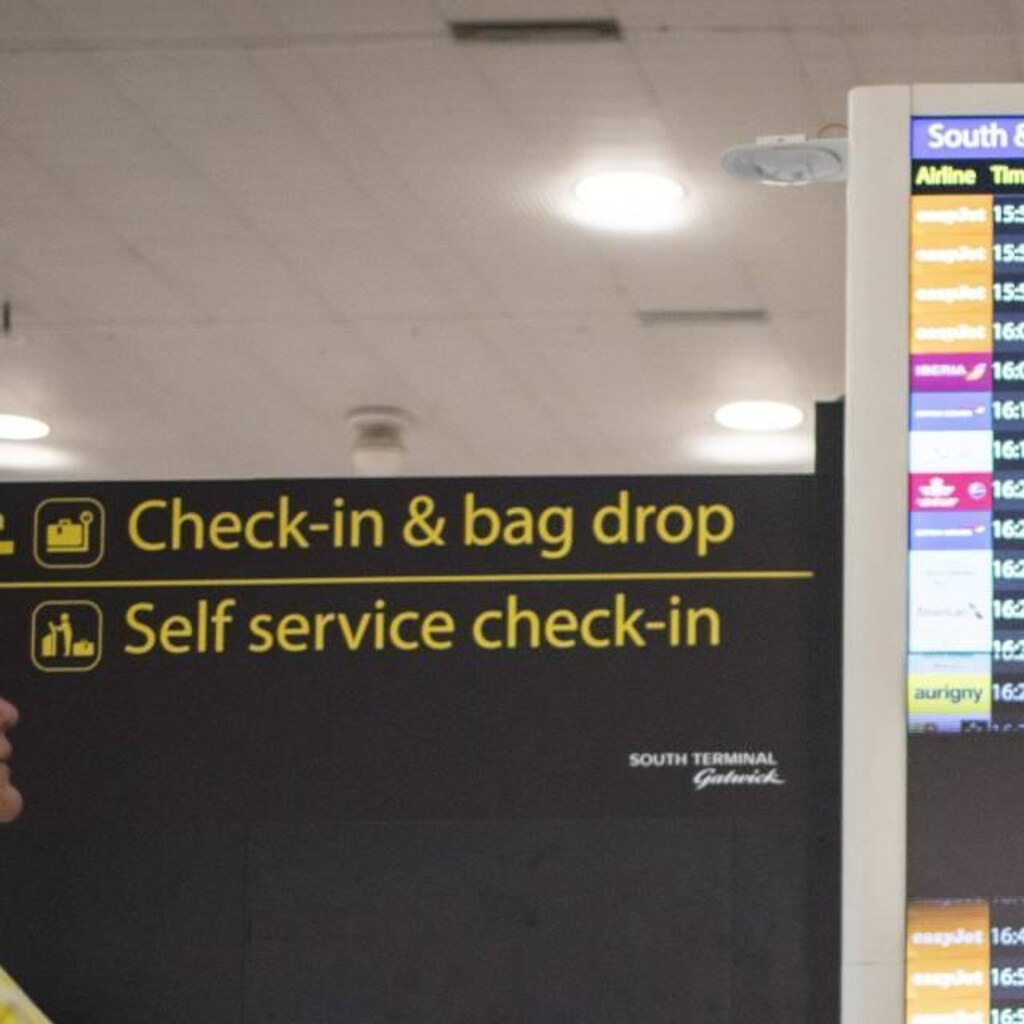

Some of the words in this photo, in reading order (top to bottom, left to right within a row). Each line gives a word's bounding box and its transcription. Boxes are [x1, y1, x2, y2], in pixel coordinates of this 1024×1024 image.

[927, 121, 1009, 150] South
[915, 165, 977, 185] Airline
[127, 493, 384, 552] Check-in
[402, 494, 446, 548] &
[463, 491, 574, 560] bag
[591, 489, 735, 558] drop
[124, 597, 237, 655] Self
[248, 598, 456, 653] service
[471, 592, 721, 650] check-in
[914, 684, 983, 703] aurigny
[629, 752, 688, 767] SOUTH
[692, 751, 777, 766] TERMINAL
[692, 767, 785, 791] Gatwick
